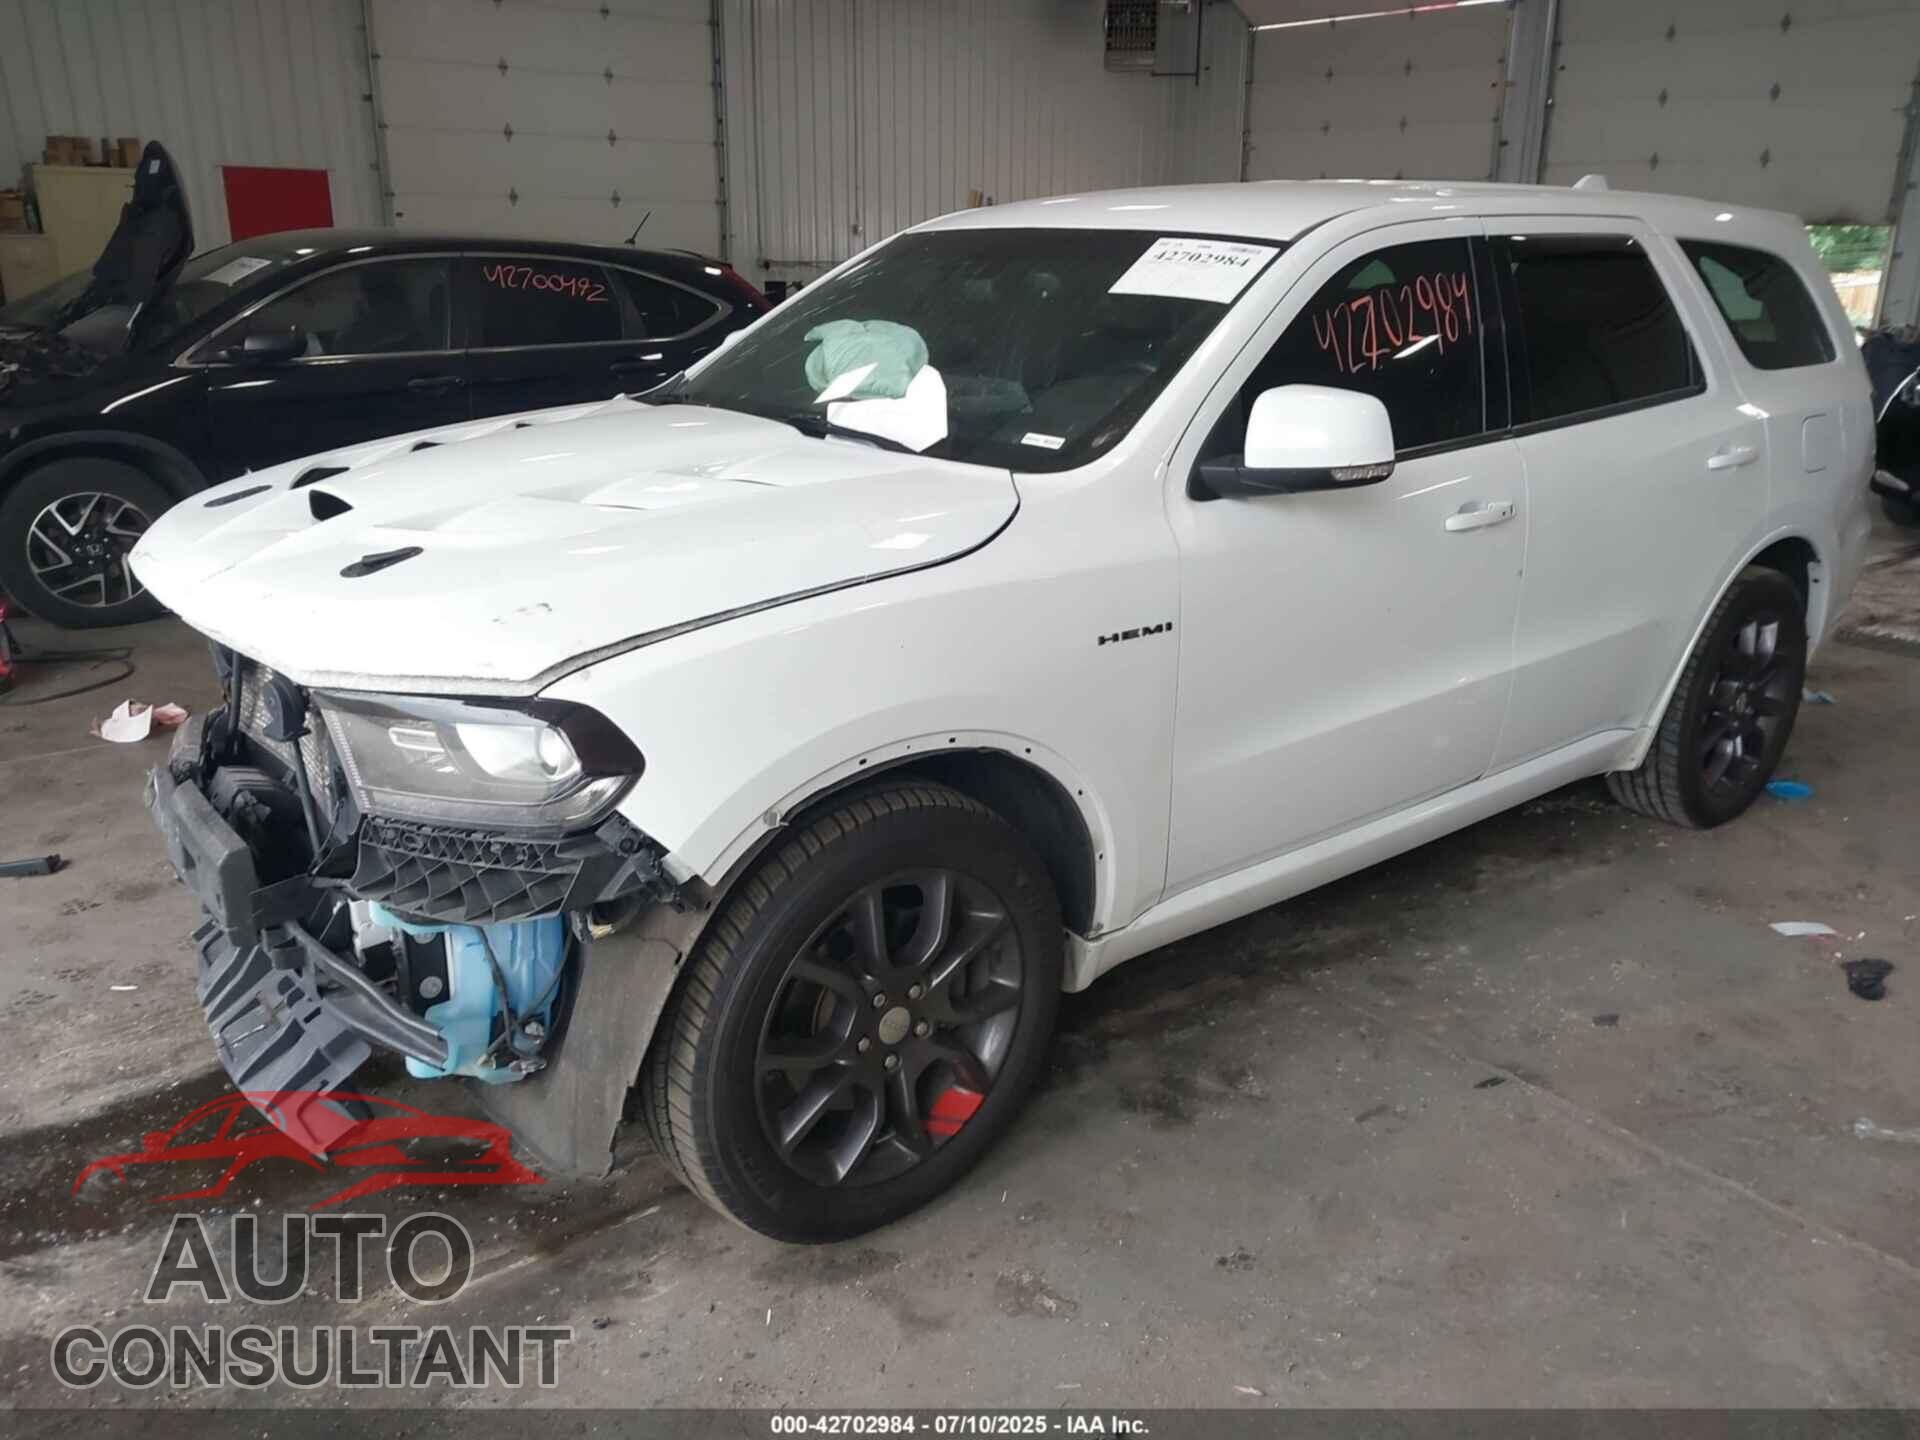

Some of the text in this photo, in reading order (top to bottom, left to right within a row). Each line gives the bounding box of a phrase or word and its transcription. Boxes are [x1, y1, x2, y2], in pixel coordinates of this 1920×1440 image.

[1153, 249, 1250, 268] 42702984
[483, 264, 608, 302] 42700492
[1313, 271, 1472, 373] 42702984
[1098, 622, 1172, 646] HEMI
